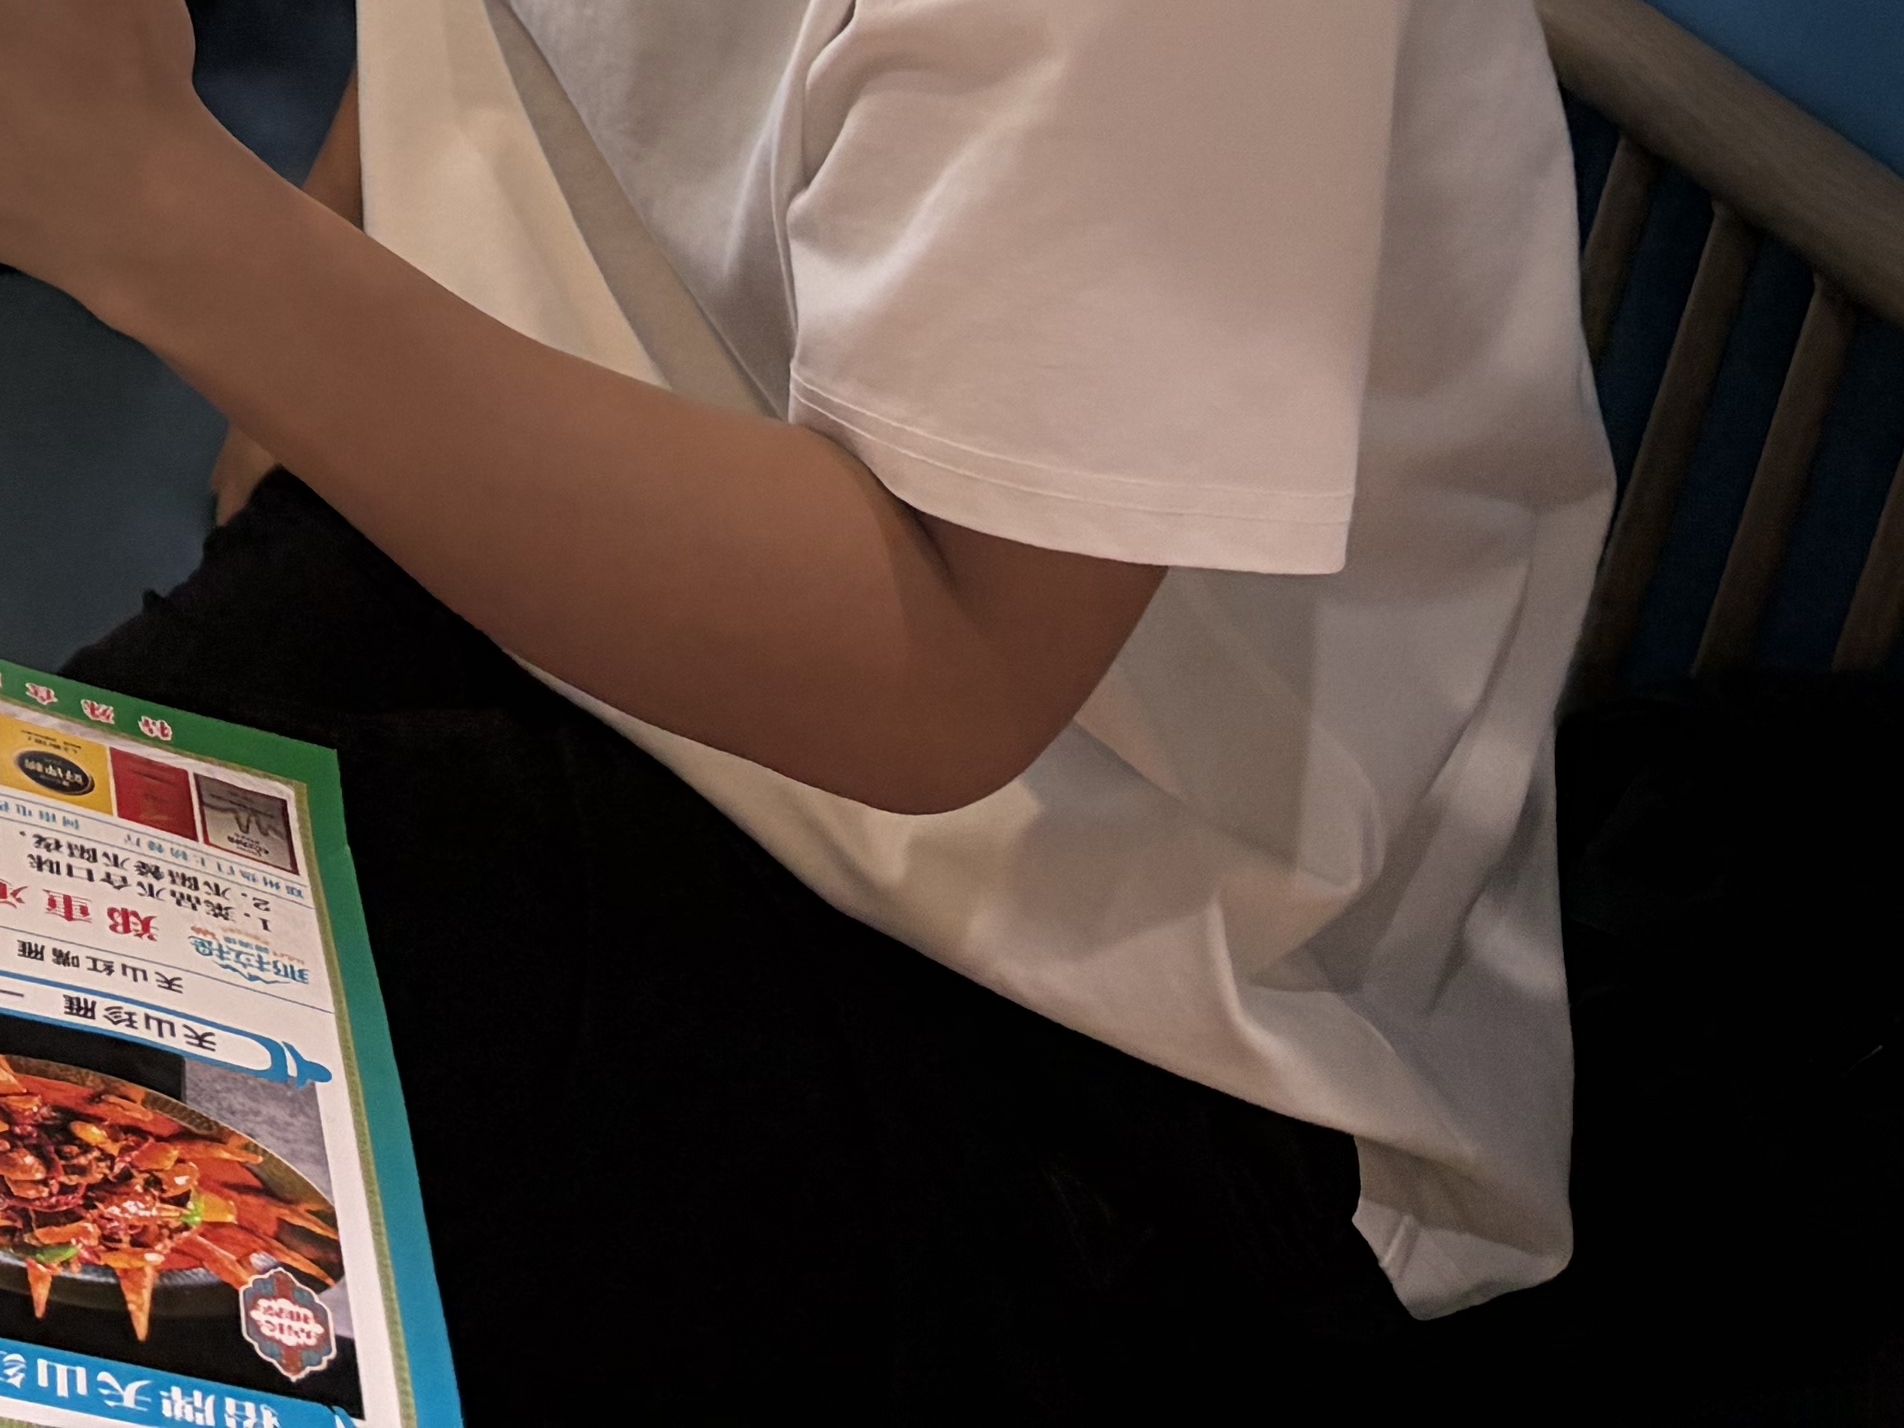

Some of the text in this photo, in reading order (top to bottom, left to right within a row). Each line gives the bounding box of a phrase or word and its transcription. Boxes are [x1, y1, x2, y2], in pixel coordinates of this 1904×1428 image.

[16, 940, 183, 994] 天山红嘴雁
[63, 995, 216, 1052] 天山珍雁
